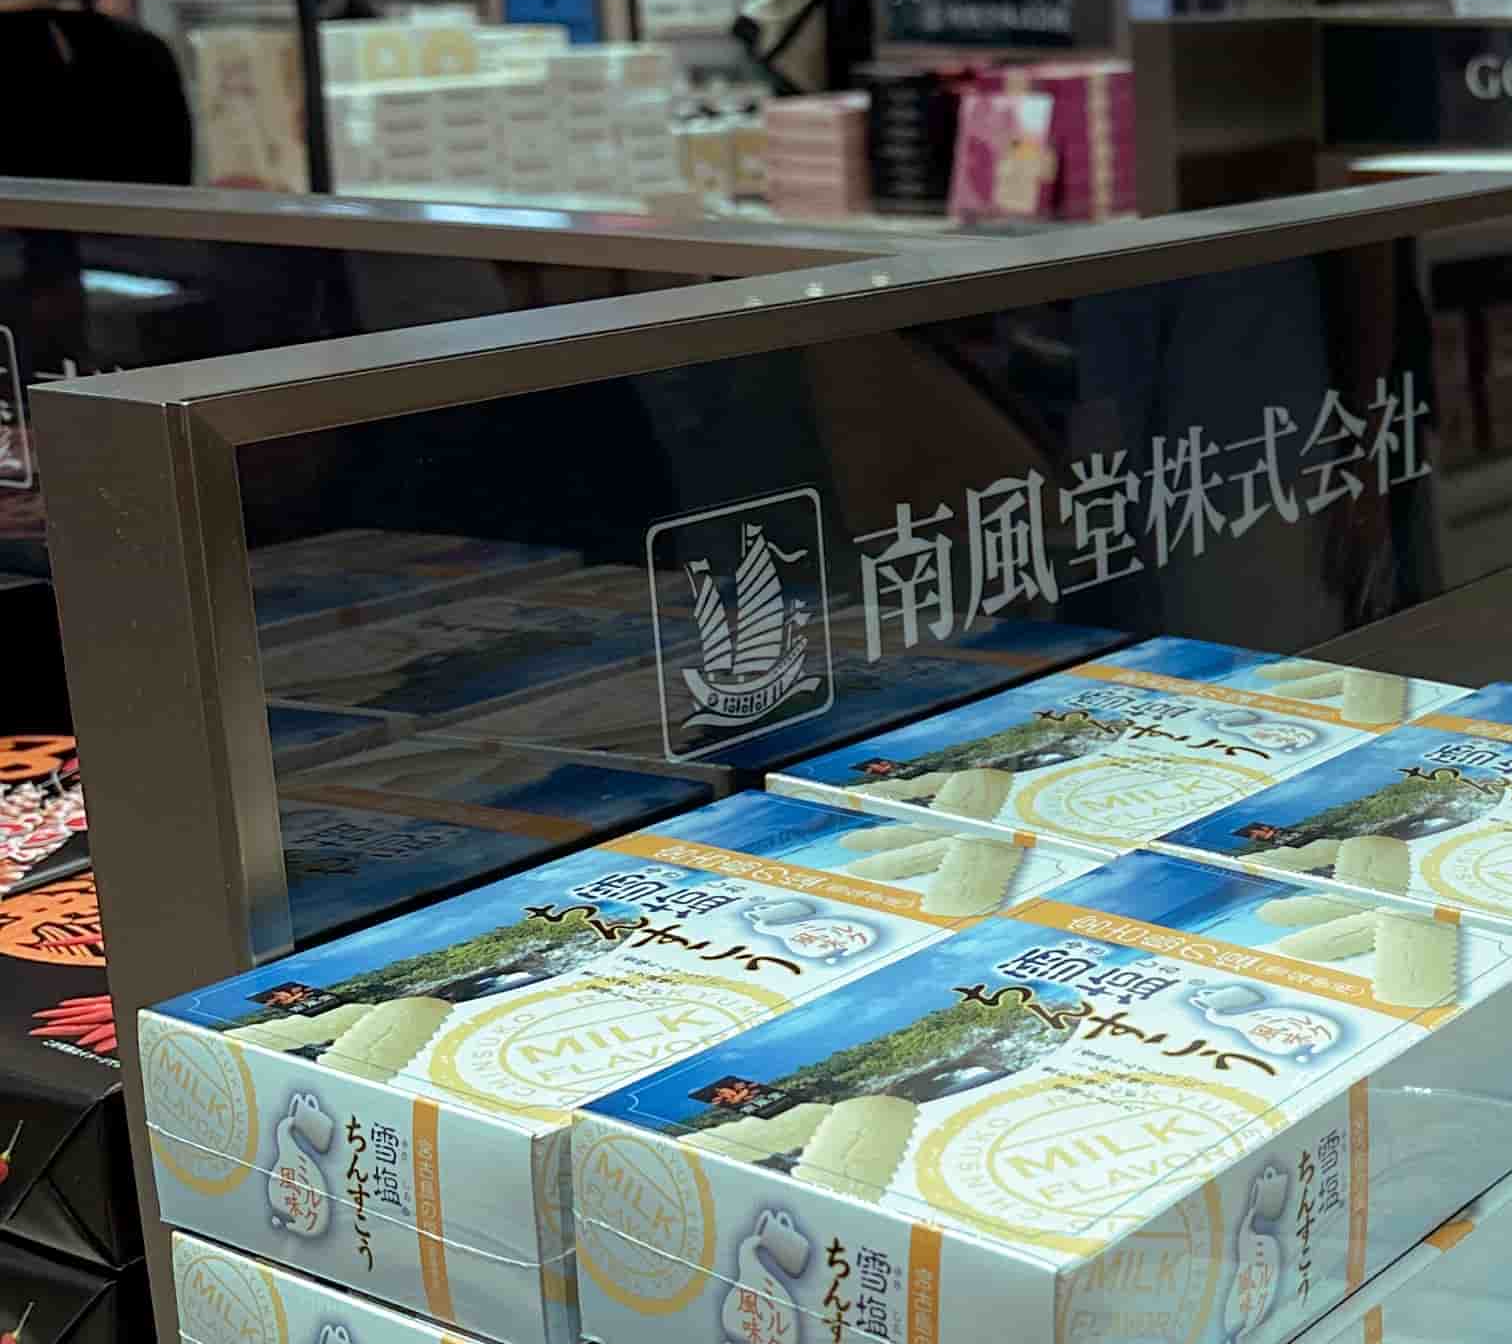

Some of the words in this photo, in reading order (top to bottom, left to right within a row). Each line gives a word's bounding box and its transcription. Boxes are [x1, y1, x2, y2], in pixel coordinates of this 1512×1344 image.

[853, 371, 1433, 663] 南風堂株式会社
[519, 1008, 713, 1064] MILK
[952, 981, 1278, 1077] ちんすこう
[160, 1045, 227, 1127] MILK
[1004, 1113, 1208, 1181] MILK
[345, 1115, 375, 1272] ちんすこう
[594, 1150, 677, 1240] MILK
[191, 1272, 259, 1340] MILK
[855, 1246, 889, 1342] 雪塩
